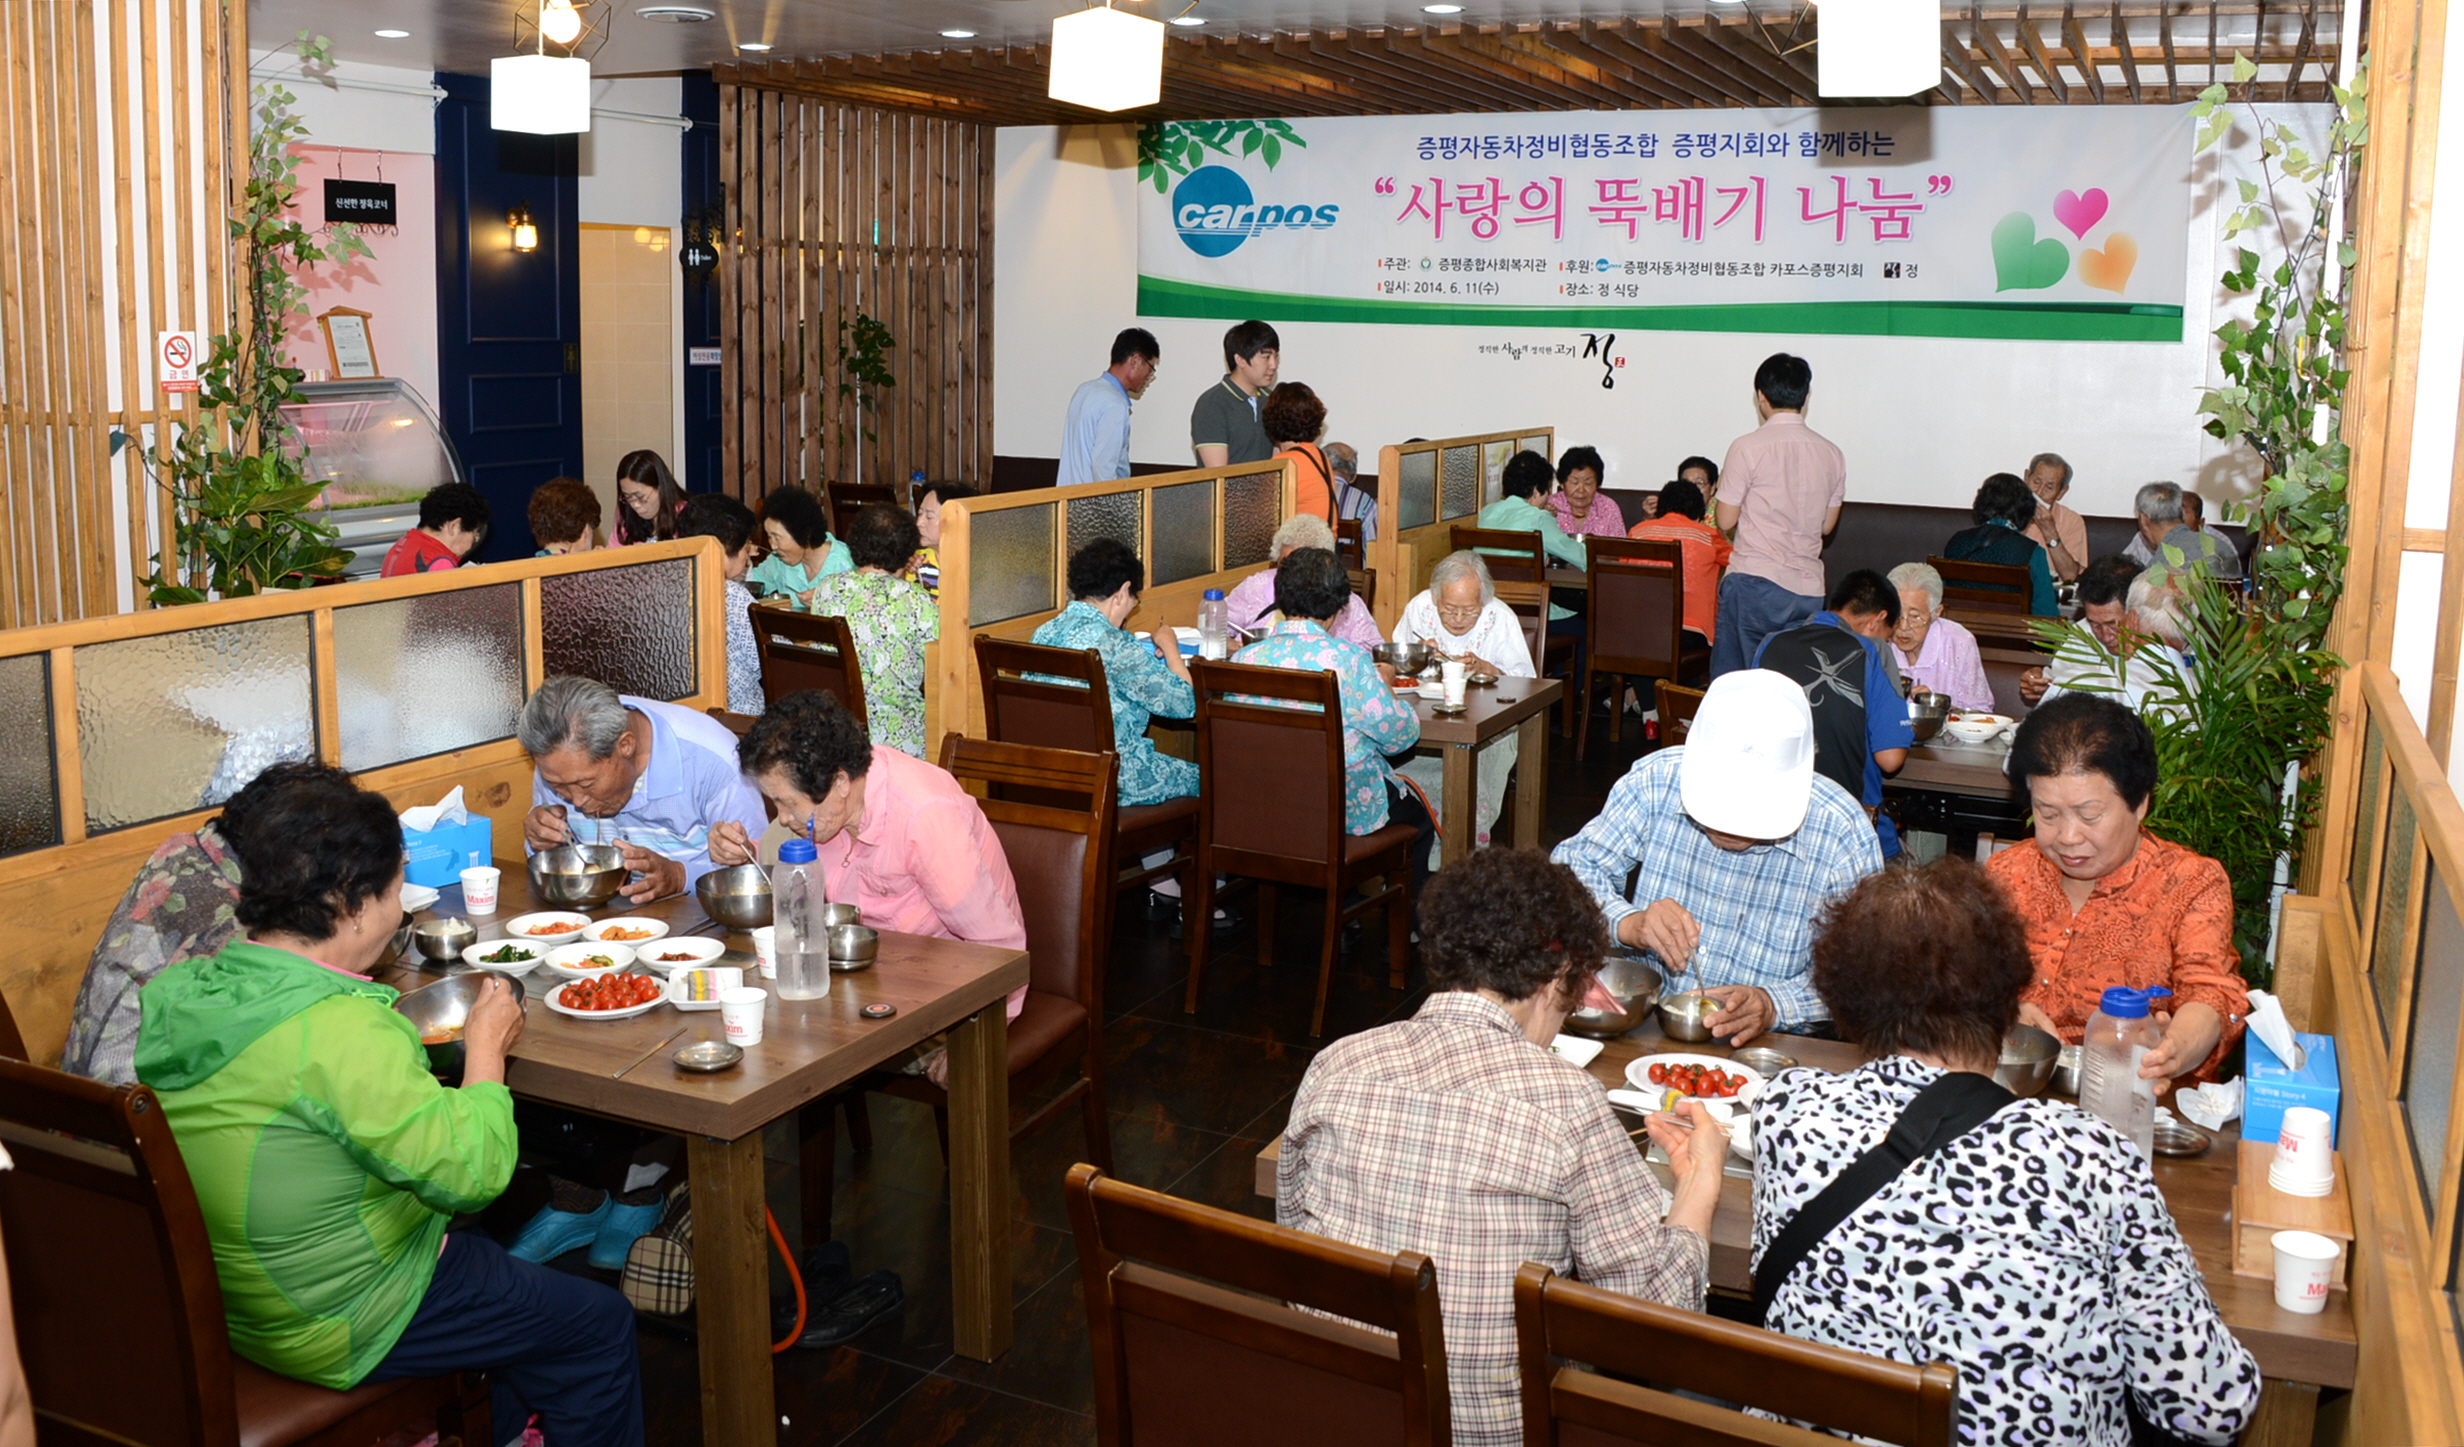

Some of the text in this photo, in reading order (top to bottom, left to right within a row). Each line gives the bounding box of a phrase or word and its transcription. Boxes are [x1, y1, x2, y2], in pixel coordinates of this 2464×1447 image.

[1416, 131, 1895, 161] 증평자동차정비협동조합 증평지회와 함께하는
[335, 198, 358, 209] 신선한
[1374, 175, 1953, 242] “사랑의 뚝배기 나눔”
[1178, 203, 1340, 237] carpos
[1383, 257, 1548, 273] 주관: 증평종합사회복지관
[1565, 258, 1594, 274] 후원:
[1623, 260, 1766, 277] 증평자동차정비협동조합
[1769, 261, 1864, 278] 카포스증평지회
[1905, 263, 1918, 279] 정
[1383, 280, 1500, 296] 일시: 2014. 6. 11(수)
[1565, 283, 1639, 298] 장소: 정 식당
[1478, 333, 1615, 390] 정직한 사람의 정직한 고기 정
[466, 893, 495, 905] Maxim
